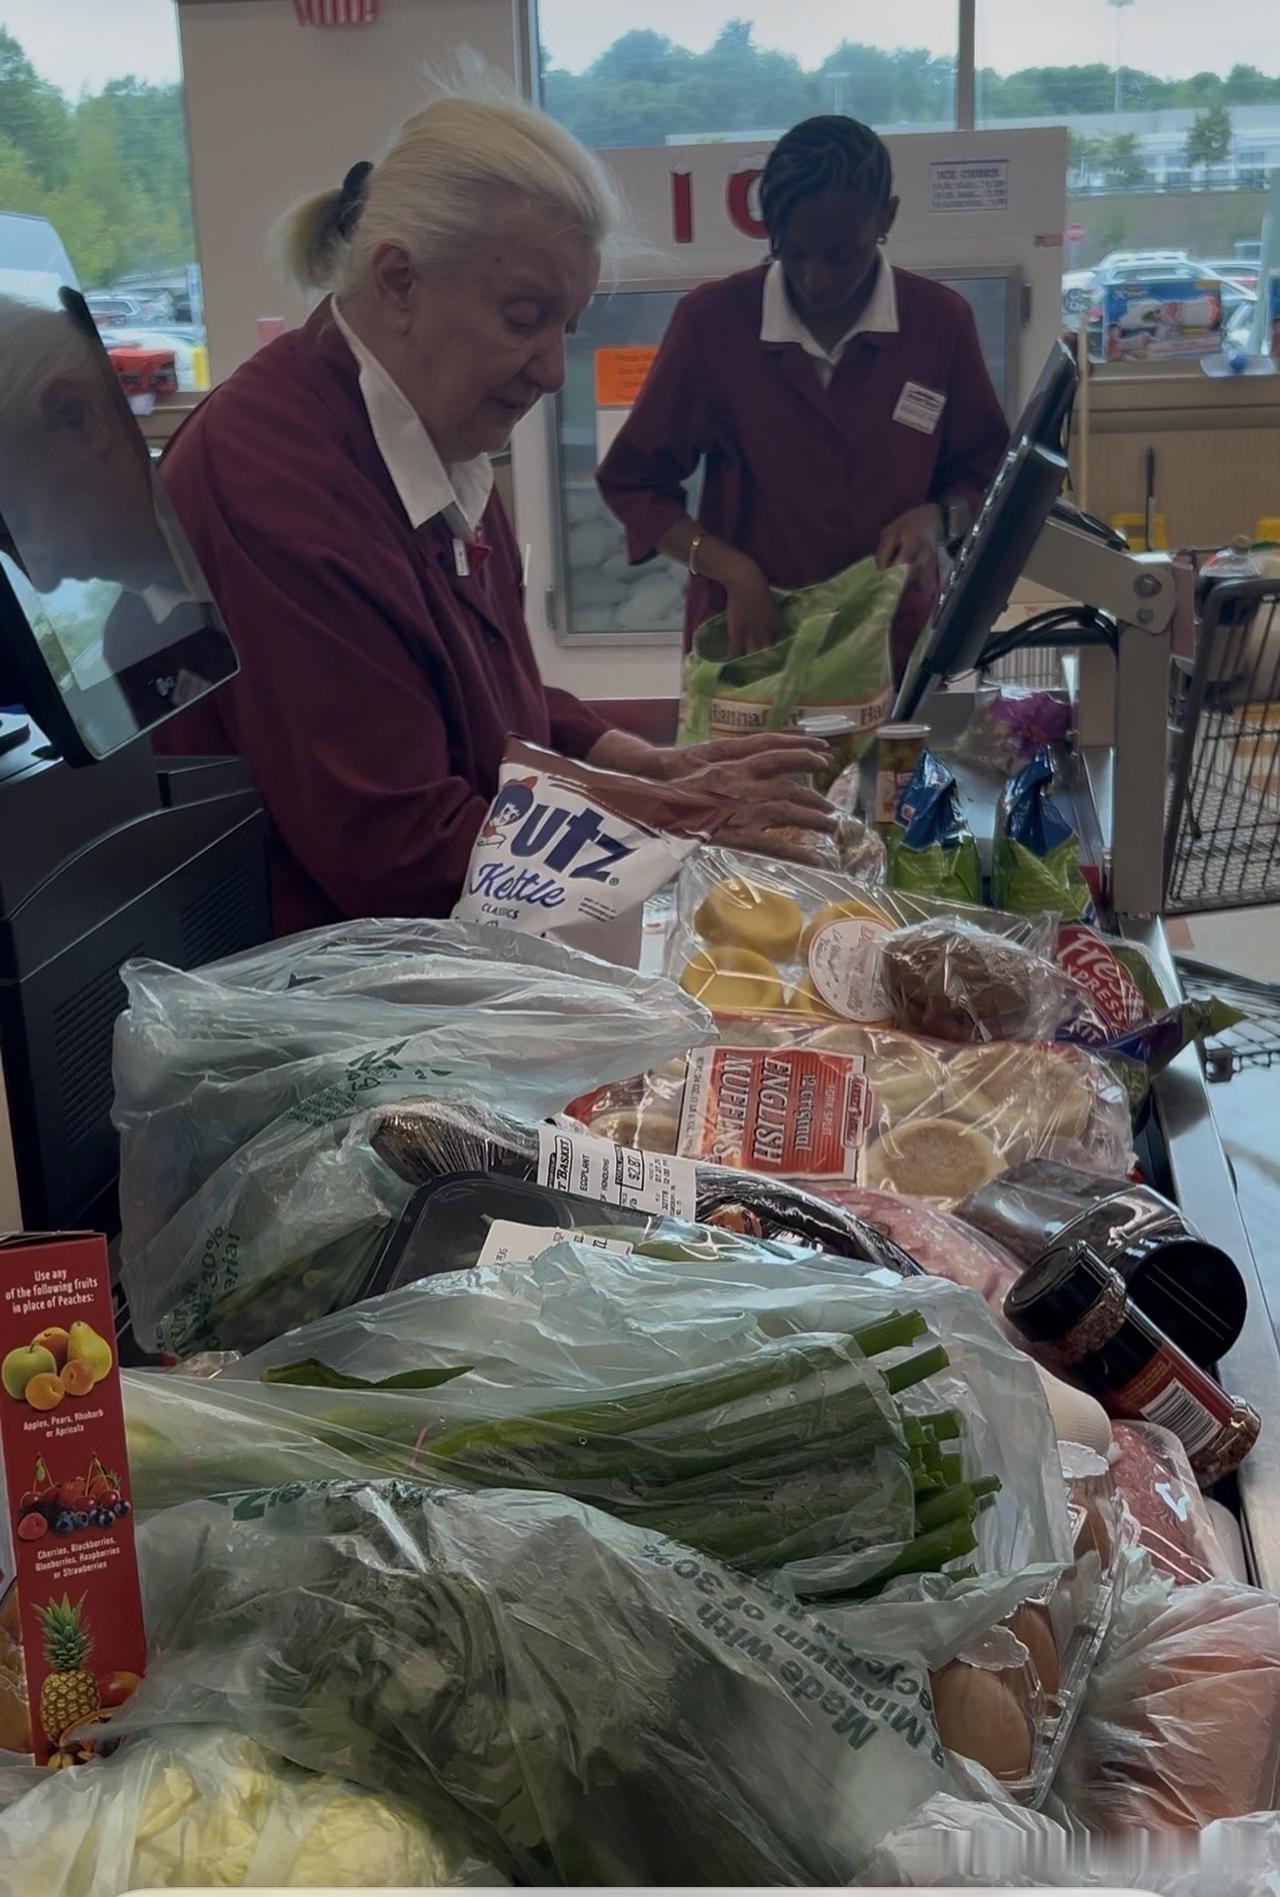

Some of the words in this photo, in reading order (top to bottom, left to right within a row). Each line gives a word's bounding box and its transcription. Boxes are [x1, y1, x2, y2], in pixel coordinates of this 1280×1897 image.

[671, 159, 768, 244] IC
[469, 862, 565, 908] Kettle
[1067, 963, 1127, 1026] XPRESS
[801, 1074, 817, 1086] 12
[824, 1084, 836, 1111] FORK
[714, 1056, 752, 1161] MUFFINS
[754, 1057, 793, 1165] ENGLISH
[794, 1088, 816, 1152] original
[821, 1111, 833, 1136] SPLIT
[556, 1139, 570, 1181] BASKET
[580, 1154, 591, 1191] EGGPLANT
[34, 1270, 51, 1282] Use
[52, 1269, 67, 1280] any
[201, 1227, 225, 1288] 30%
[5, 1287, 16, 1300] of
[16, 1286, 31, 1299] the
[33, 1281, 73, 1294] following
[74, 1277, 98, 1290] fruits
[12, 1302, 21, 1314] in
[23, 1299, 45, 1314] place
[47, 1295, 57, 1308] of
[58, 1293, 95, 1306] Peaches:
[23, 1419, 50, 1432] Apples,
[74, 1408, 104, 1422] Rhubarb
[46, 1430, 54, 1438] or
[55, 1424, 85, 1437] Apricots
[35, 1557, 78, 1572] Blueberries,
[79, 1546, 121, 1563] Raspberries
[37, 1548, 70, 1560] Cherries,
[71, 1536, 117, 1552] Blackberries,
[53, 1572, 62, 1580] or
[63, 1561, 108, 1578] Strawberries
[643, 1543, 724, 1594] 30%
[722, 1594, 765, 1621] of
[697, 1603, 774, 1664] with
[773, 1623, 926, 1748] Minimum
[780, 1659, 878, 1750] Made
